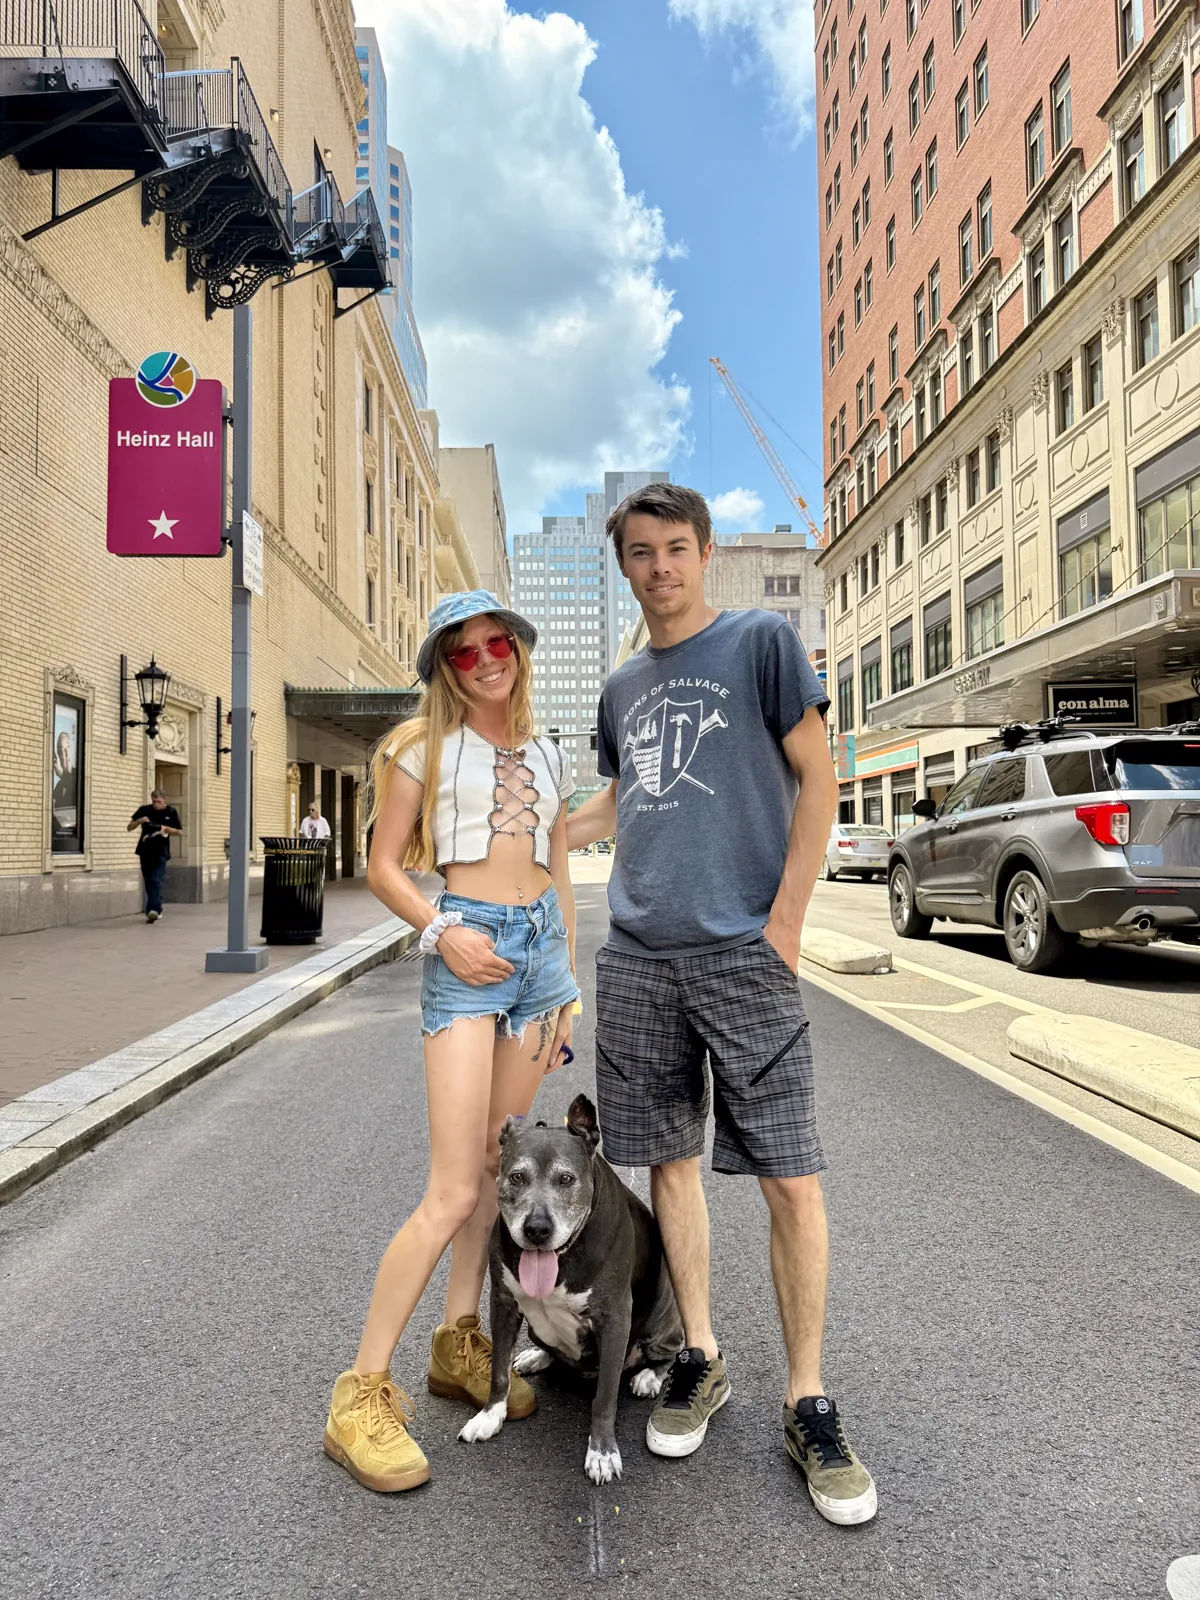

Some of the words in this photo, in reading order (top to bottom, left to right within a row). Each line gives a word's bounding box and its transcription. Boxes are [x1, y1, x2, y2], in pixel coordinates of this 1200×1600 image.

[117, 430, 171, 447] Heinz
[177, 431, 214, 448] Hall
[624, 694, 648, 724] SONS
[650, 683, 665, 696] OF
[668, 677, 731, 699] SALVAGE
[1058, 700, 1088, 710] con
[1088, 697, 1130, 709] alma
[658, 801, 679, 811] 2015
